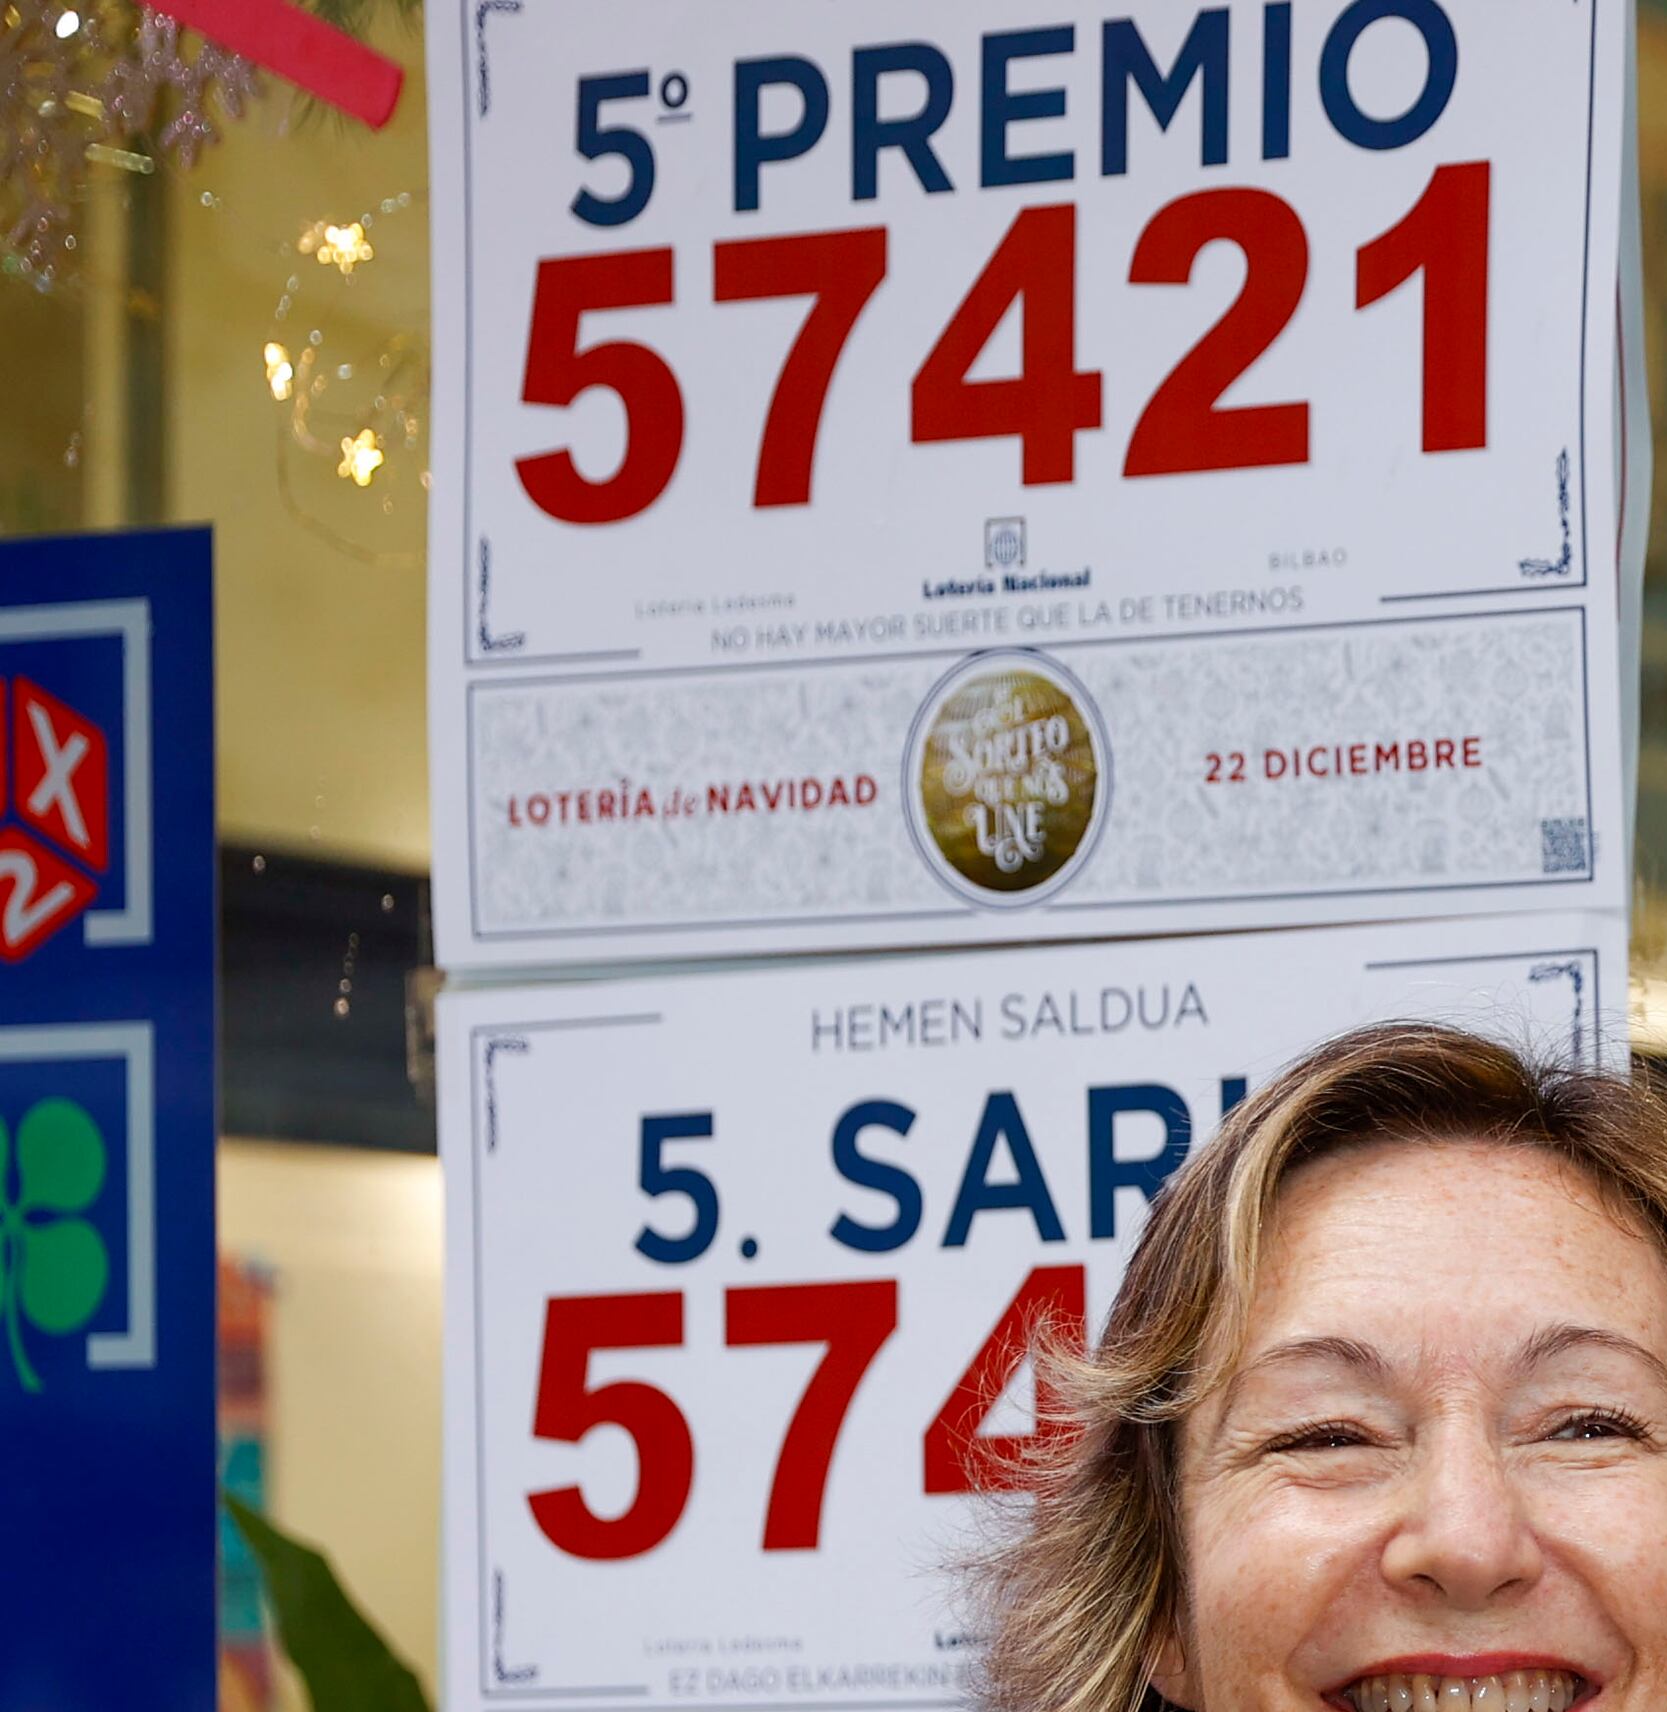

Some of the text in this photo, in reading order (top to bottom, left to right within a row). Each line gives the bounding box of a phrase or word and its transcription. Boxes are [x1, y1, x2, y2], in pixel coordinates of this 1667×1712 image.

[733, 0, 1459, 213] PREMIO
[513, 159, 1493, 527] 57421
[1267, 547, 1348, 571] BILBAO
[710, 585, 1305, 650] NO HAY MAYOR SUERTE QUE LA DE TENERNOS
[1204, 736, 1482, 784] 22 DICIEMBRE
[507, 775, 656, 829] LOTERÍA
[705, 772, 880, 816] NAVIDAD
[811, 981, 1210, 1052] HEMEN SALDUA
[633, 1109, 760, 1265] 5.
[668, 1667, 698, 1696] EZ
[705, 1665, 780, 1695] DAGO
